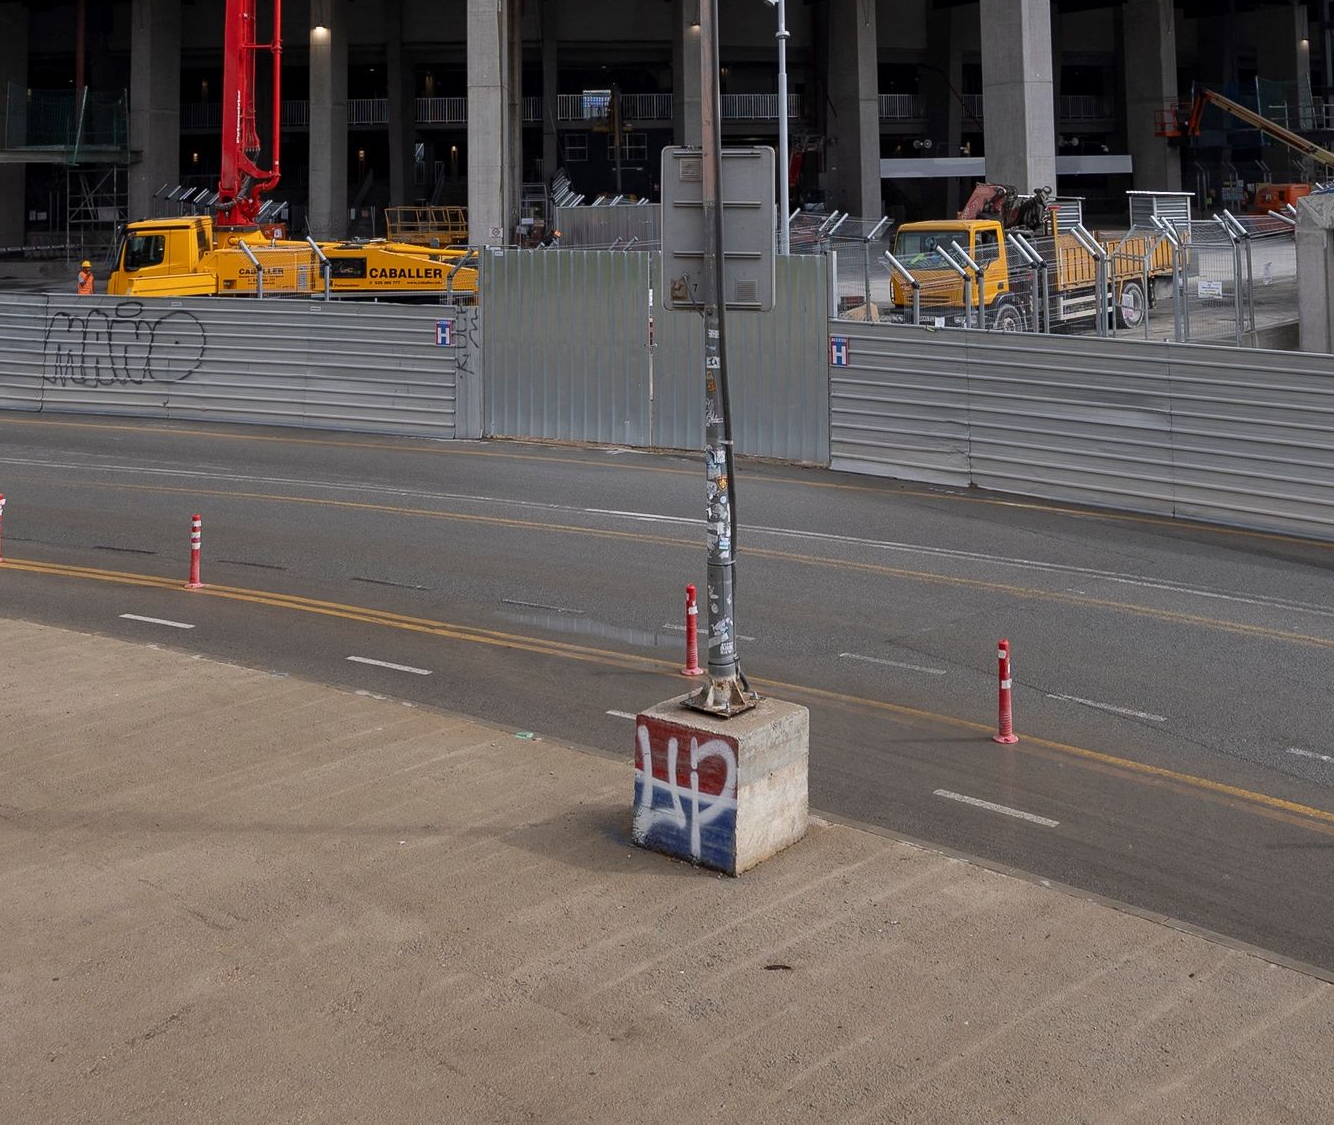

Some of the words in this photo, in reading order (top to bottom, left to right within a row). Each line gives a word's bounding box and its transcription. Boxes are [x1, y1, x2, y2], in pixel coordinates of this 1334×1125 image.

[369, 268, 443, 279] CABALLER
[437, 327, 450, 345] H
[832, 345, 847, 365] H
